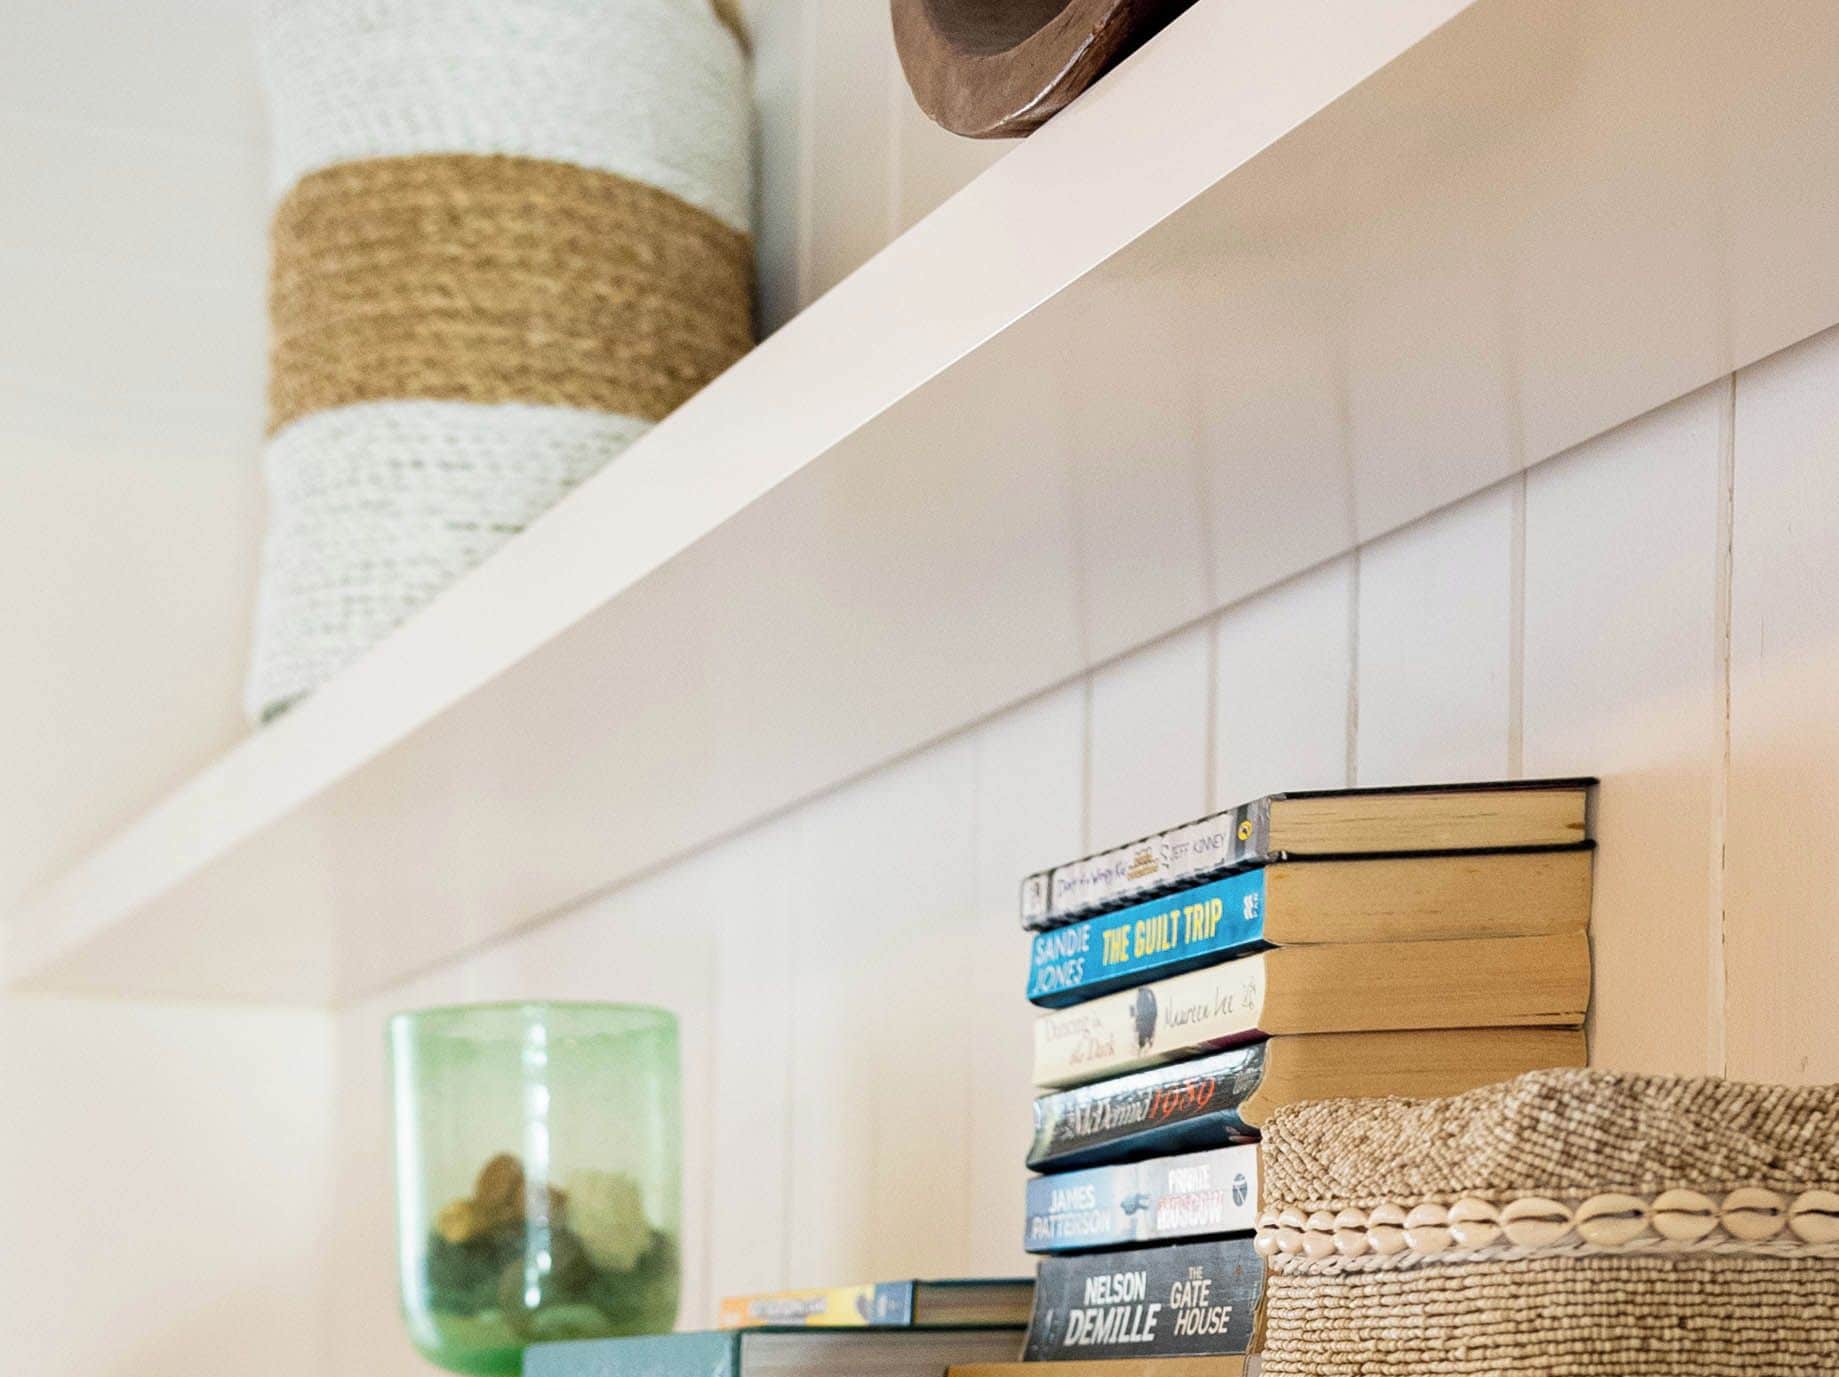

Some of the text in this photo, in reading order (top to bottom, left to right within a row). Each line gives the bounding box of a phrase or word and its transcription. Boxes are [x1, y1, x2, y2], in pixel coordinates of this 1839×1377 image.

[1034, 924, 1091, 966] SANDIE
[1102, 898, 1223, 967] THE GUILT TRIP
[1032, 957, 1085, 994] JONES
[1165, 984, 1233, 1028] Maureen Lee
[1048, 1183, 1096, 1213] JAMES
[1031, 1209, 1112, 1241] PATTERSON
[1083, 1271, 1147, 1306] NELSON
[1188, 1265, 1204, 1280] THE
[1170, 1279, 1212, 1310] GATE
[1063, 1302, 1162, 1347] DEMILLE
[1174, 1306, 1233, 1336] HOUSE
